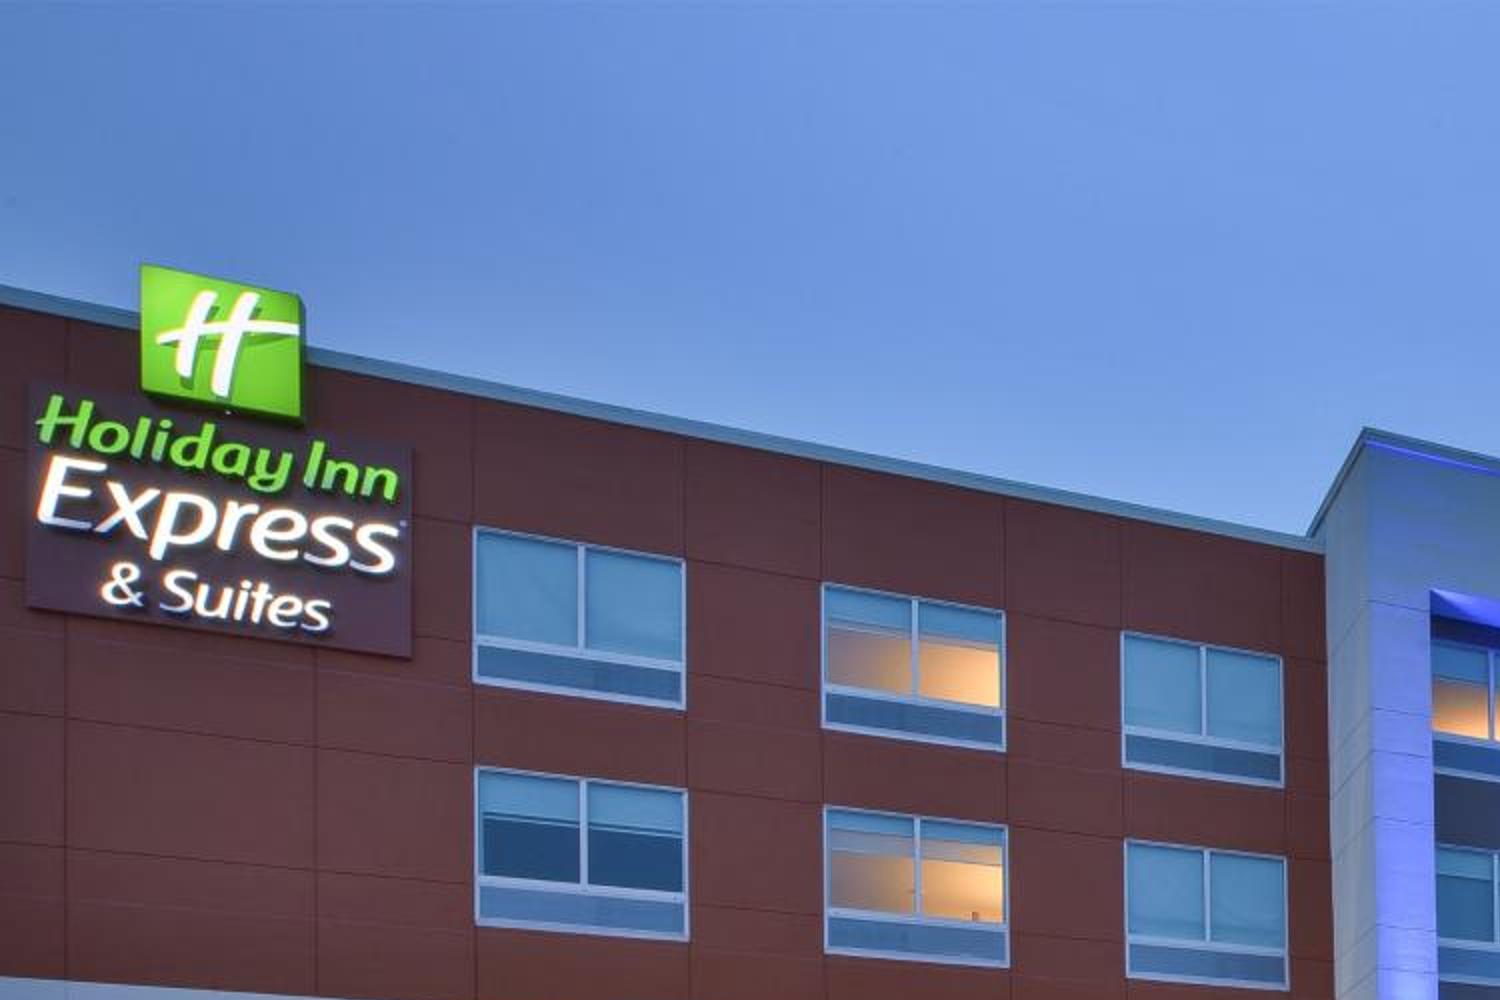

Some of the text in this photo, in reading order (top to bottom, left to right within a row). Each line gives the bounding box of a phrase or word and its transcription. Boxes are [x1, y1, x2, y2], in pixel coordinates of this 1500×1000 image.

[35, 393, 400, 502] Holiday Inn
[37, 455, 401, 575] Express
[101, 562, 331, 632] & Suites
